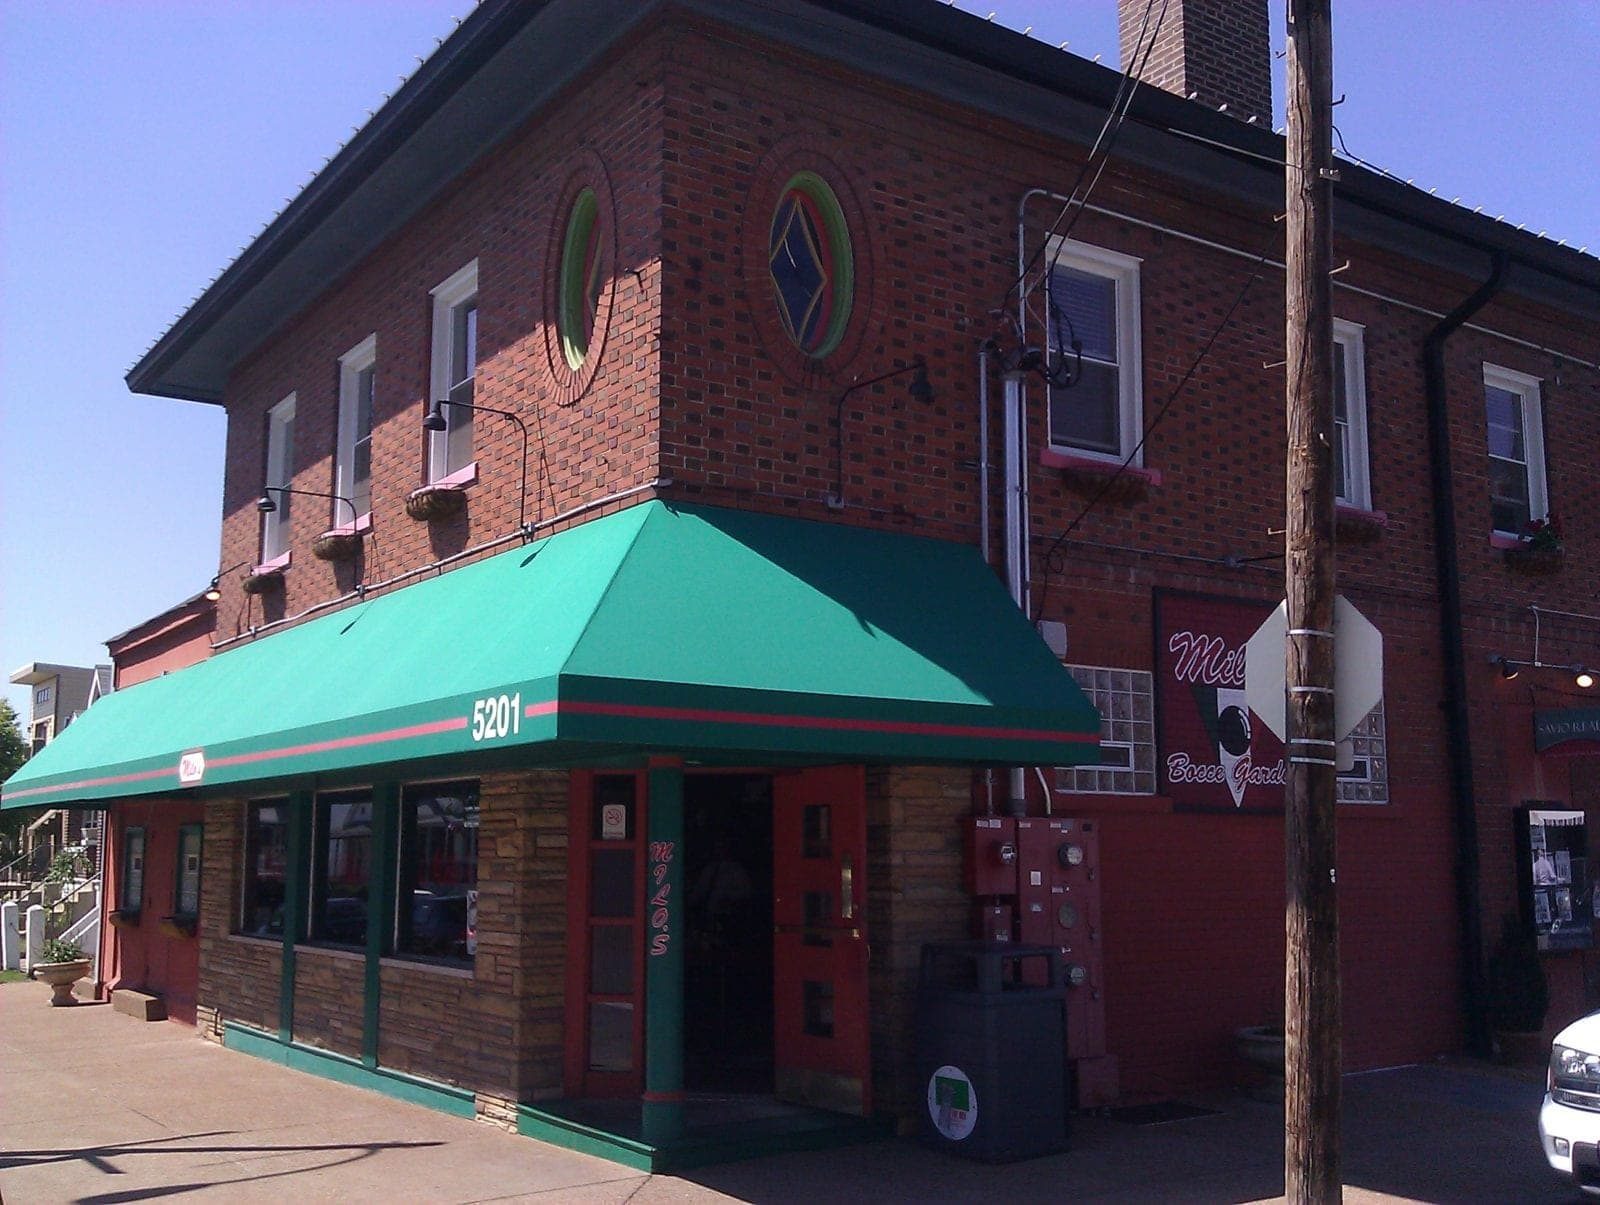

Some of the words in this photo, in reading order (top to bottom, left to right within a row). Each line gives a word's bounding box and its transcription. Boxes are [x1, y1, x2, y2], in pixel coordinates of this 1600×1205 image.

[1169, 631, 1247, 685] Mil
[472, 692, 521, 742] 5201
[1167, 752, 1225, 783] Bocce
